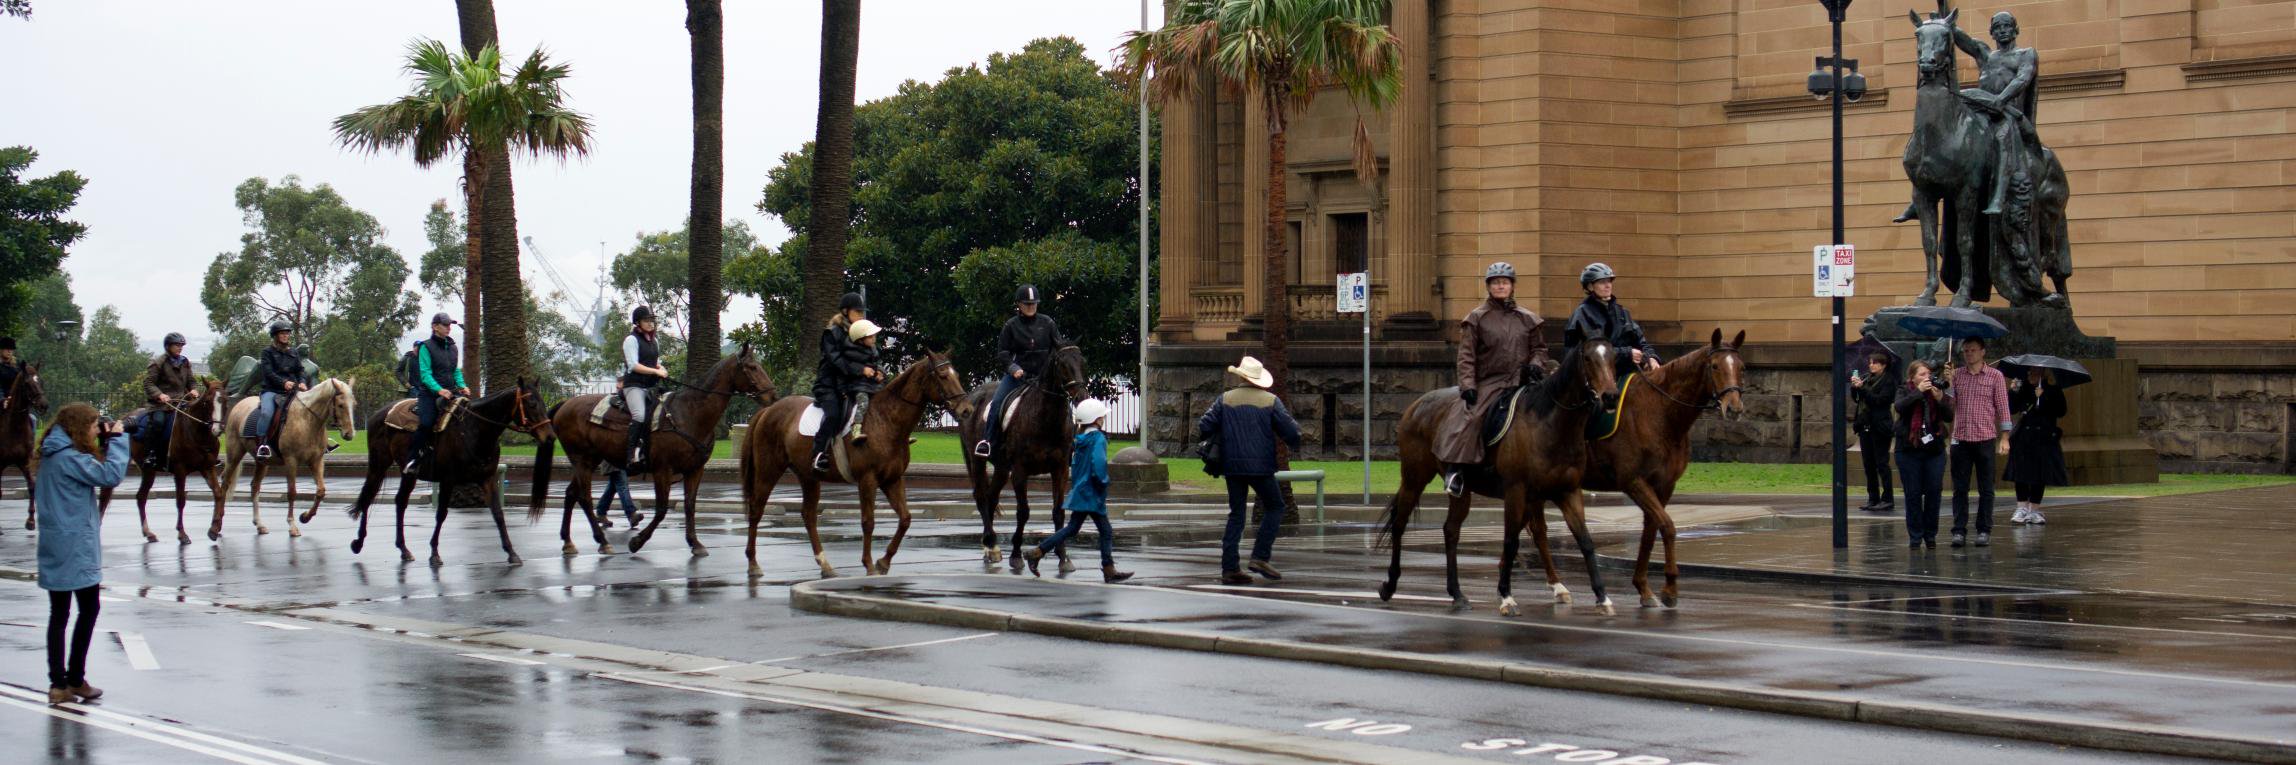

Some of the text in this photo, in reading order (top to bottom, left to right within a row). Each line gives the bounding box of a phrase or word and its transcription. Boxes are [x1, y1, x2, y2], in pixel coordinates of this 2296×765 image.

[1820, 249, 1828, 261] P
[1835, 257, 1852, 265] ZONE
[1356, 276, 1362, 285] P
[1304, 718, 1412, 735] NO
